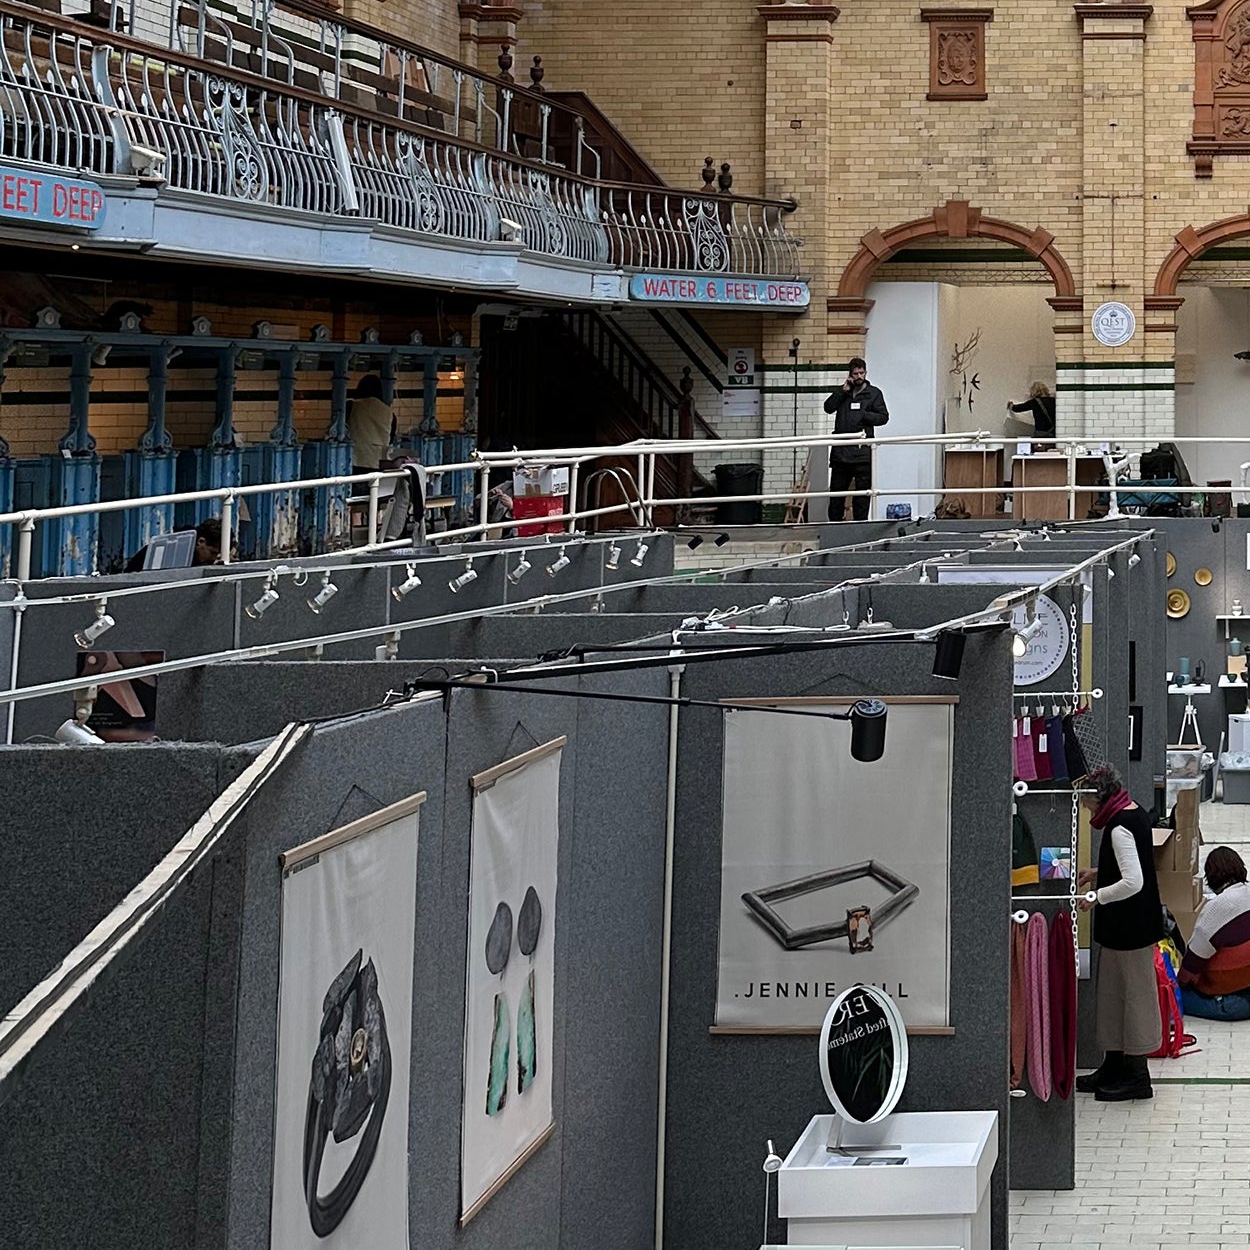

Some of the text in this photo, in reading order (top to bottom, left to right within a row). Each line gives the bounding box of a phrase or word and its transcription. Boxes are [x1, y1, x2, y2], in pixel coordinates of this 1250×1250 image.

[0, 174, 102, 221] EET DEEP
[644, 278, 802, 302] WATER 6 FEET DEEP
[1101, 317, 1126, 328] QEST
